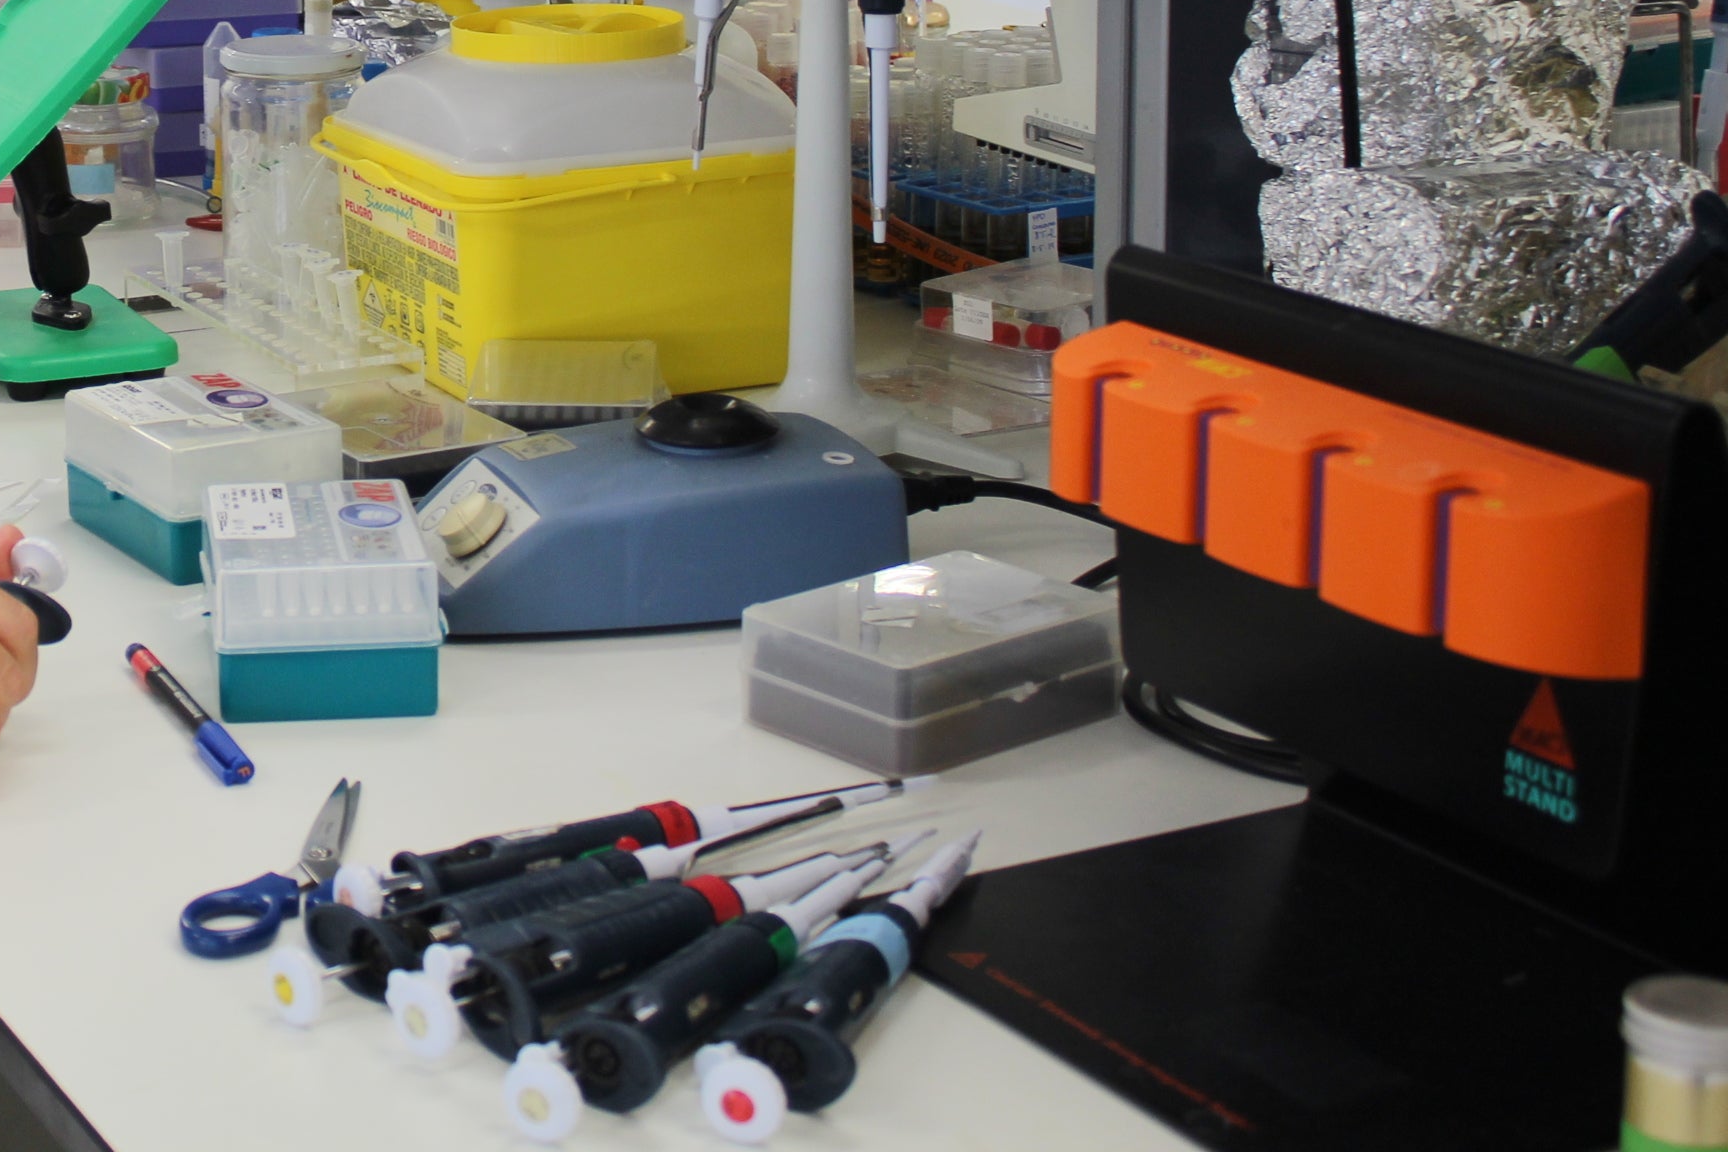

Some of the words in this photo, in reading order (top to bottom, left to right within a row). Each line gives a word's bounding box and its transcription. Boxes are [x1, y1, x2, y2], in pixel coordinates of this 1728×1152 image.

[344, 198, 374, 222] PELIGRO
[406, 227, 427, 248] RIESGO
[190, 371, 243, 389] ZAP
[352, 482, 396, 503] ZAP
[1504, 747, 1575, 797] MULTI
[1503, 774, 1577, 823] STAND
